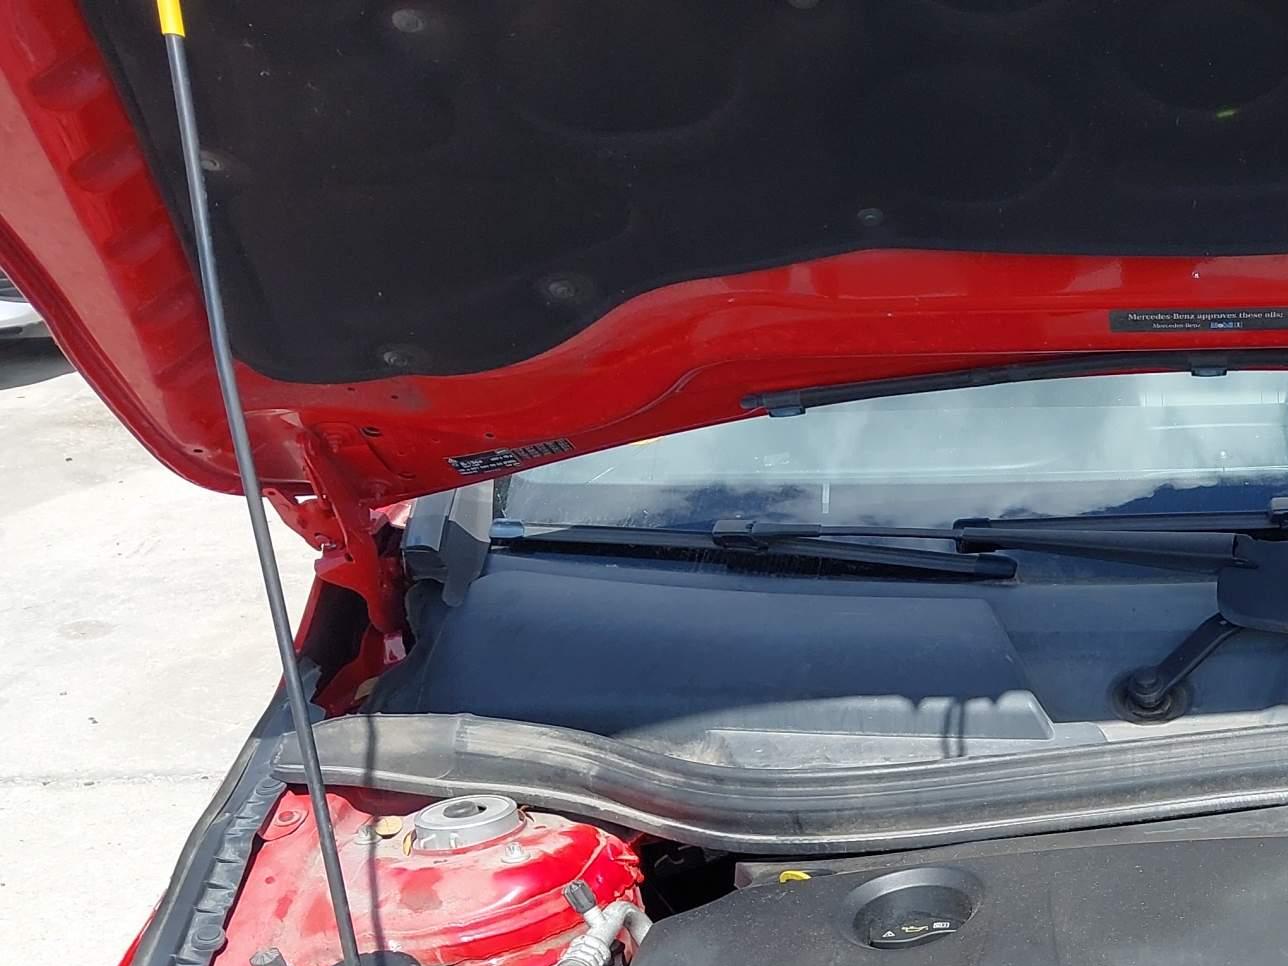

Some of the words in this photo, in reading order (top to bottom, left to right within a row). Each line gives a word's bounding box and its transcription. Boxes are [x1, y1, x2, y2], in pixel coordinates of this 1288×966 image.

[1128, 312, 1195, 321] Mercedes-Benz
[1197, 312, 1237, 320] approves
[1239, 311, 1262, 319] these
